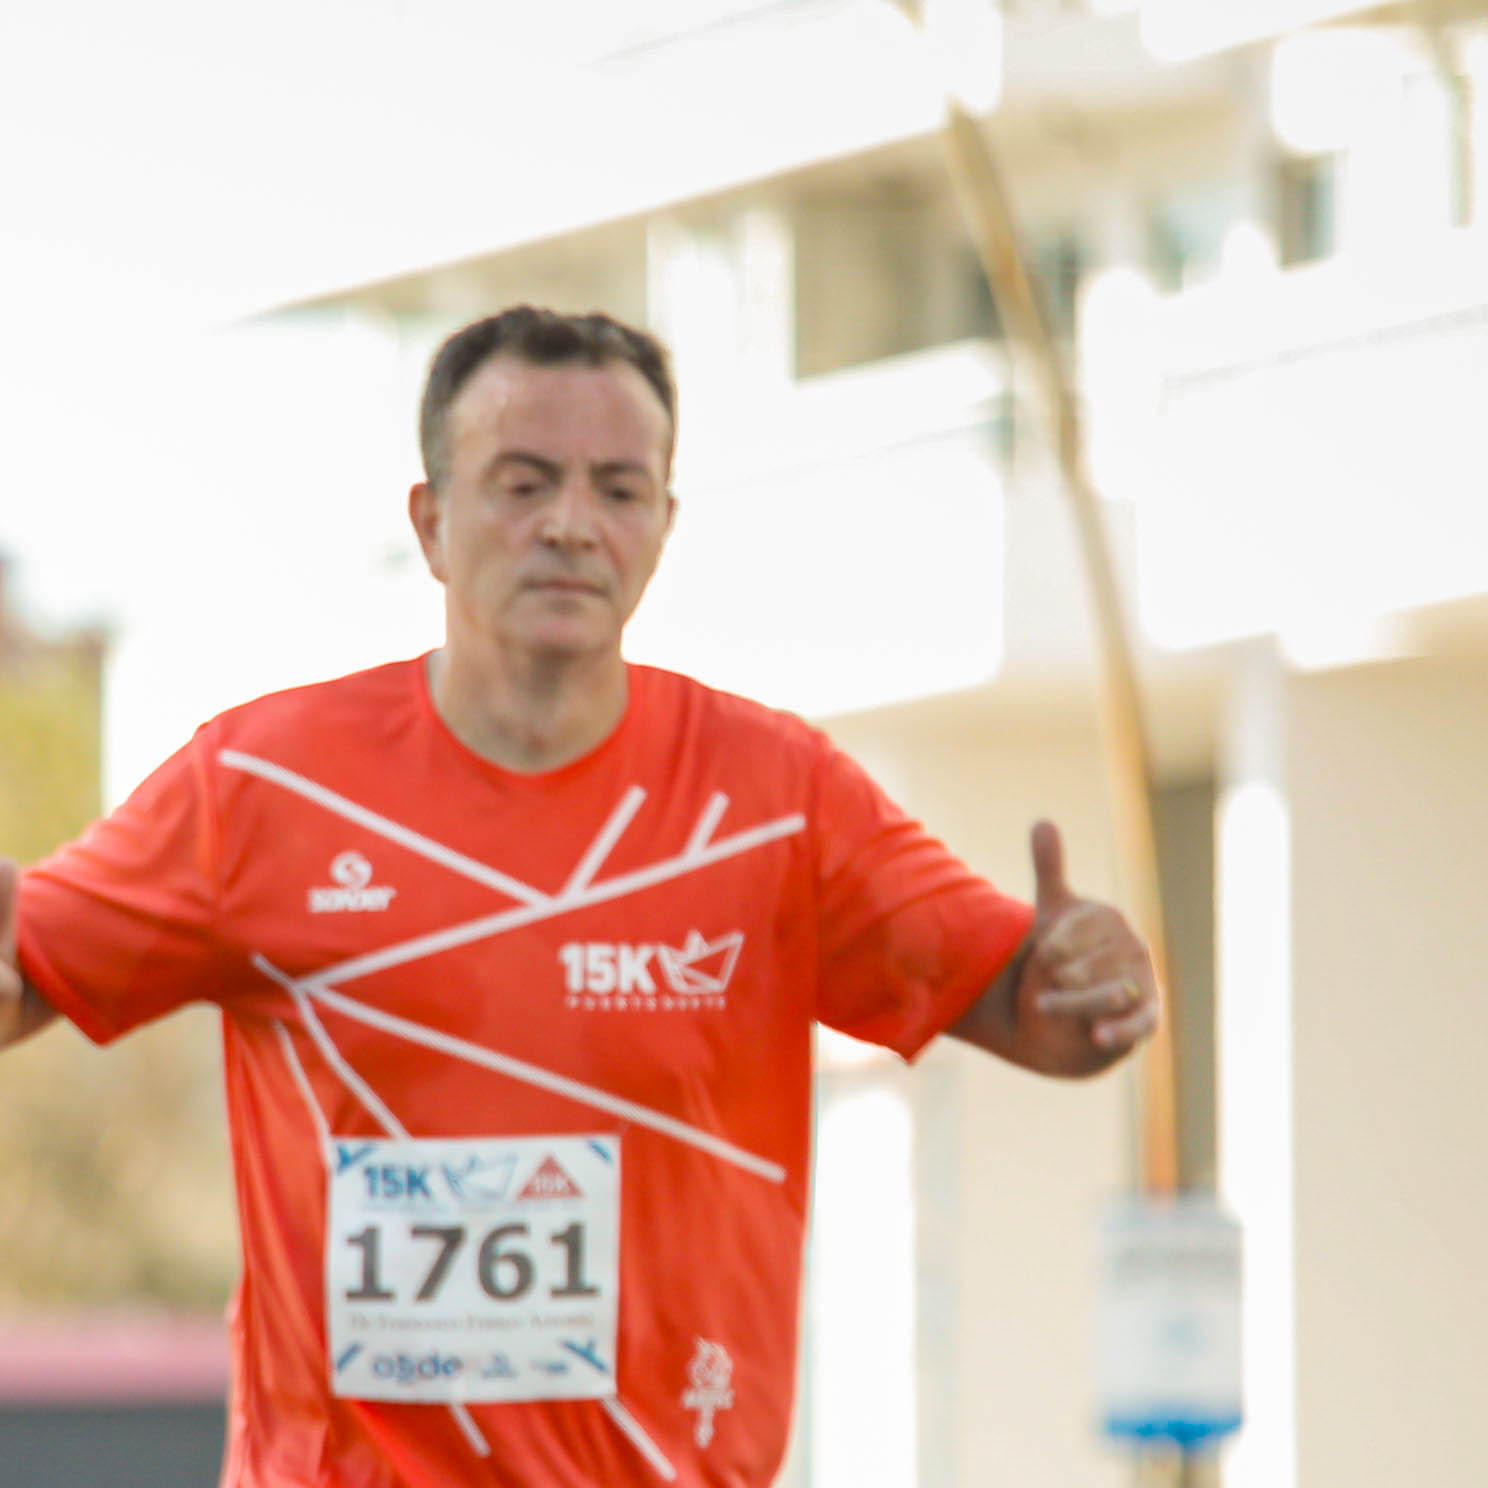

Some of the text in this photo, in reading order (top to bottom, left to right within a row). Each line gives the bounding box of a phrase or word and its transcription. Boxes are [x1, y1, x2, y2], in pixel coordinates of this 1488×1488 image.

[559, 943, 655, 992] 15K
[365, 1165, 430, 1198] 15K
[345, 1224, 600, 1301] 1761
[374, 1354, 464, 1383] osde
